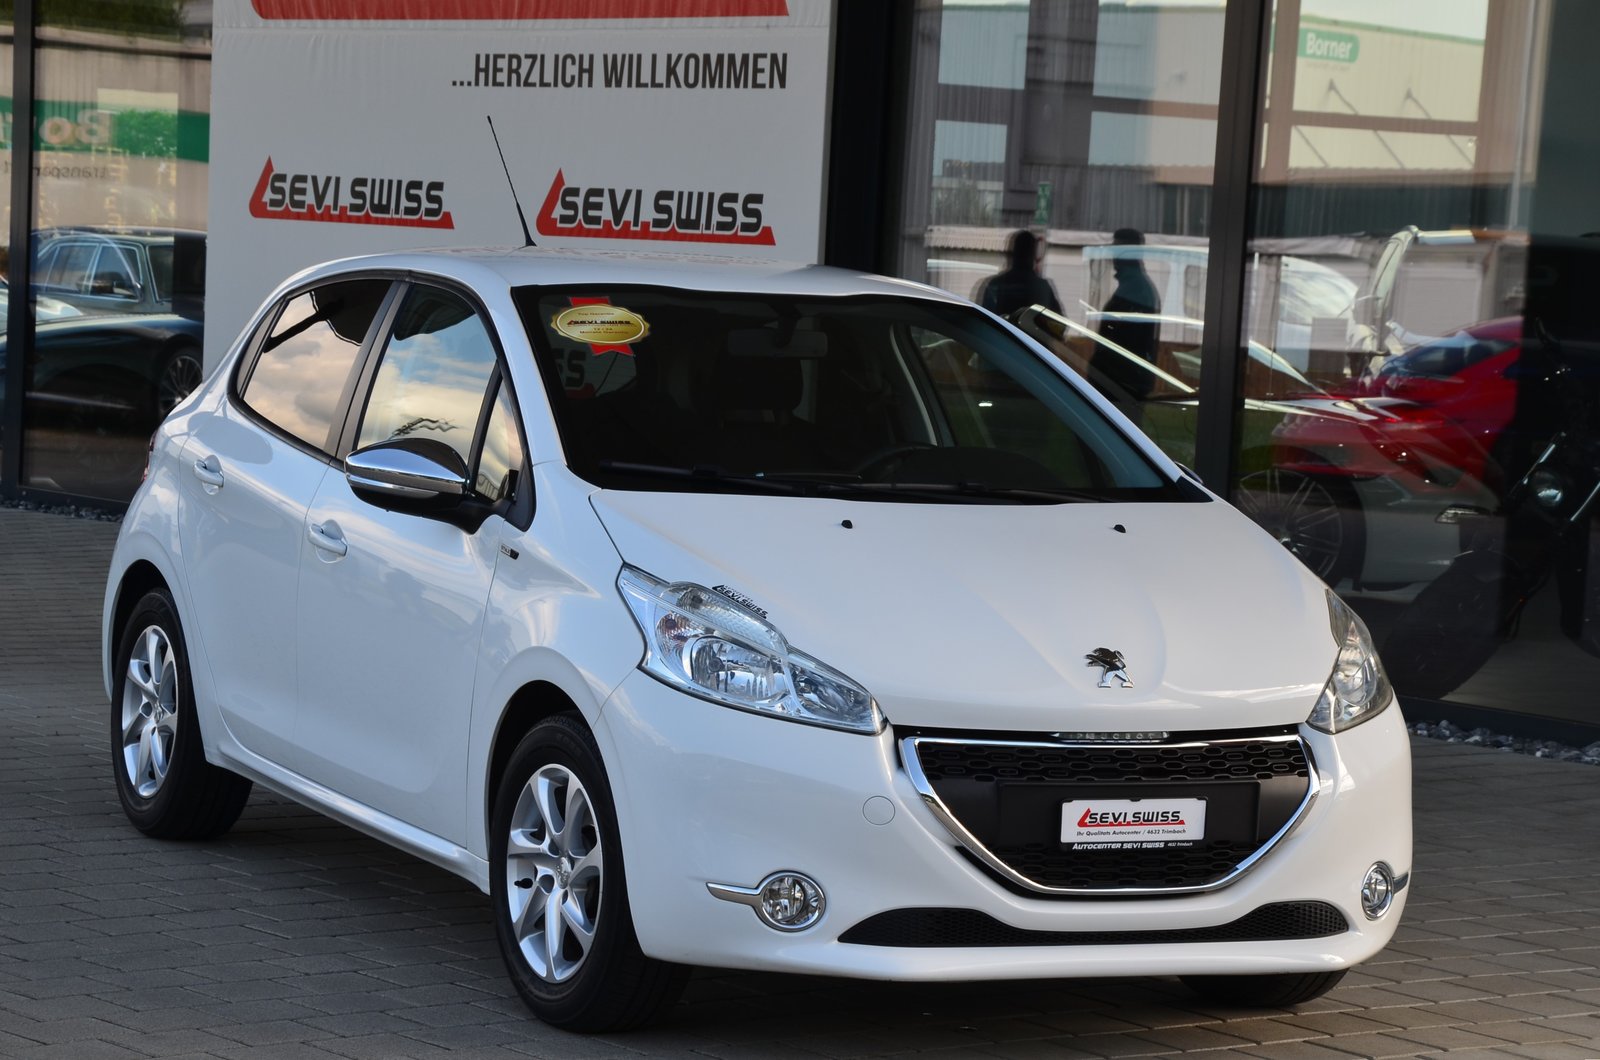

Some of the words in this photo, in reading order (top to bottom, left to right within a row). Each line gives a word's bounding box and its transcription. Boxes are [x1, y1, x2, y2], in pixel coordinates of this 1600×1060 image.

[1305, 32, 1353, 59] Borner
[451, 53, 594, 88] ...HERZLICH
[602, 53, 788, 89] WILLKOMMEN
[268, 173, 341, 213] SEVI
[348, 177, 445, 218] SWISS
[558, 187, 641, 228] SEVI
[652, 190, 765, 234] SWISS
[740, 598, 769, 617] SWISS
[1088, 812, 1128, 824] SEVI
[1132, 811, 1181, 823] SWISS
[1141, 841, 1165, 849] SWISS
